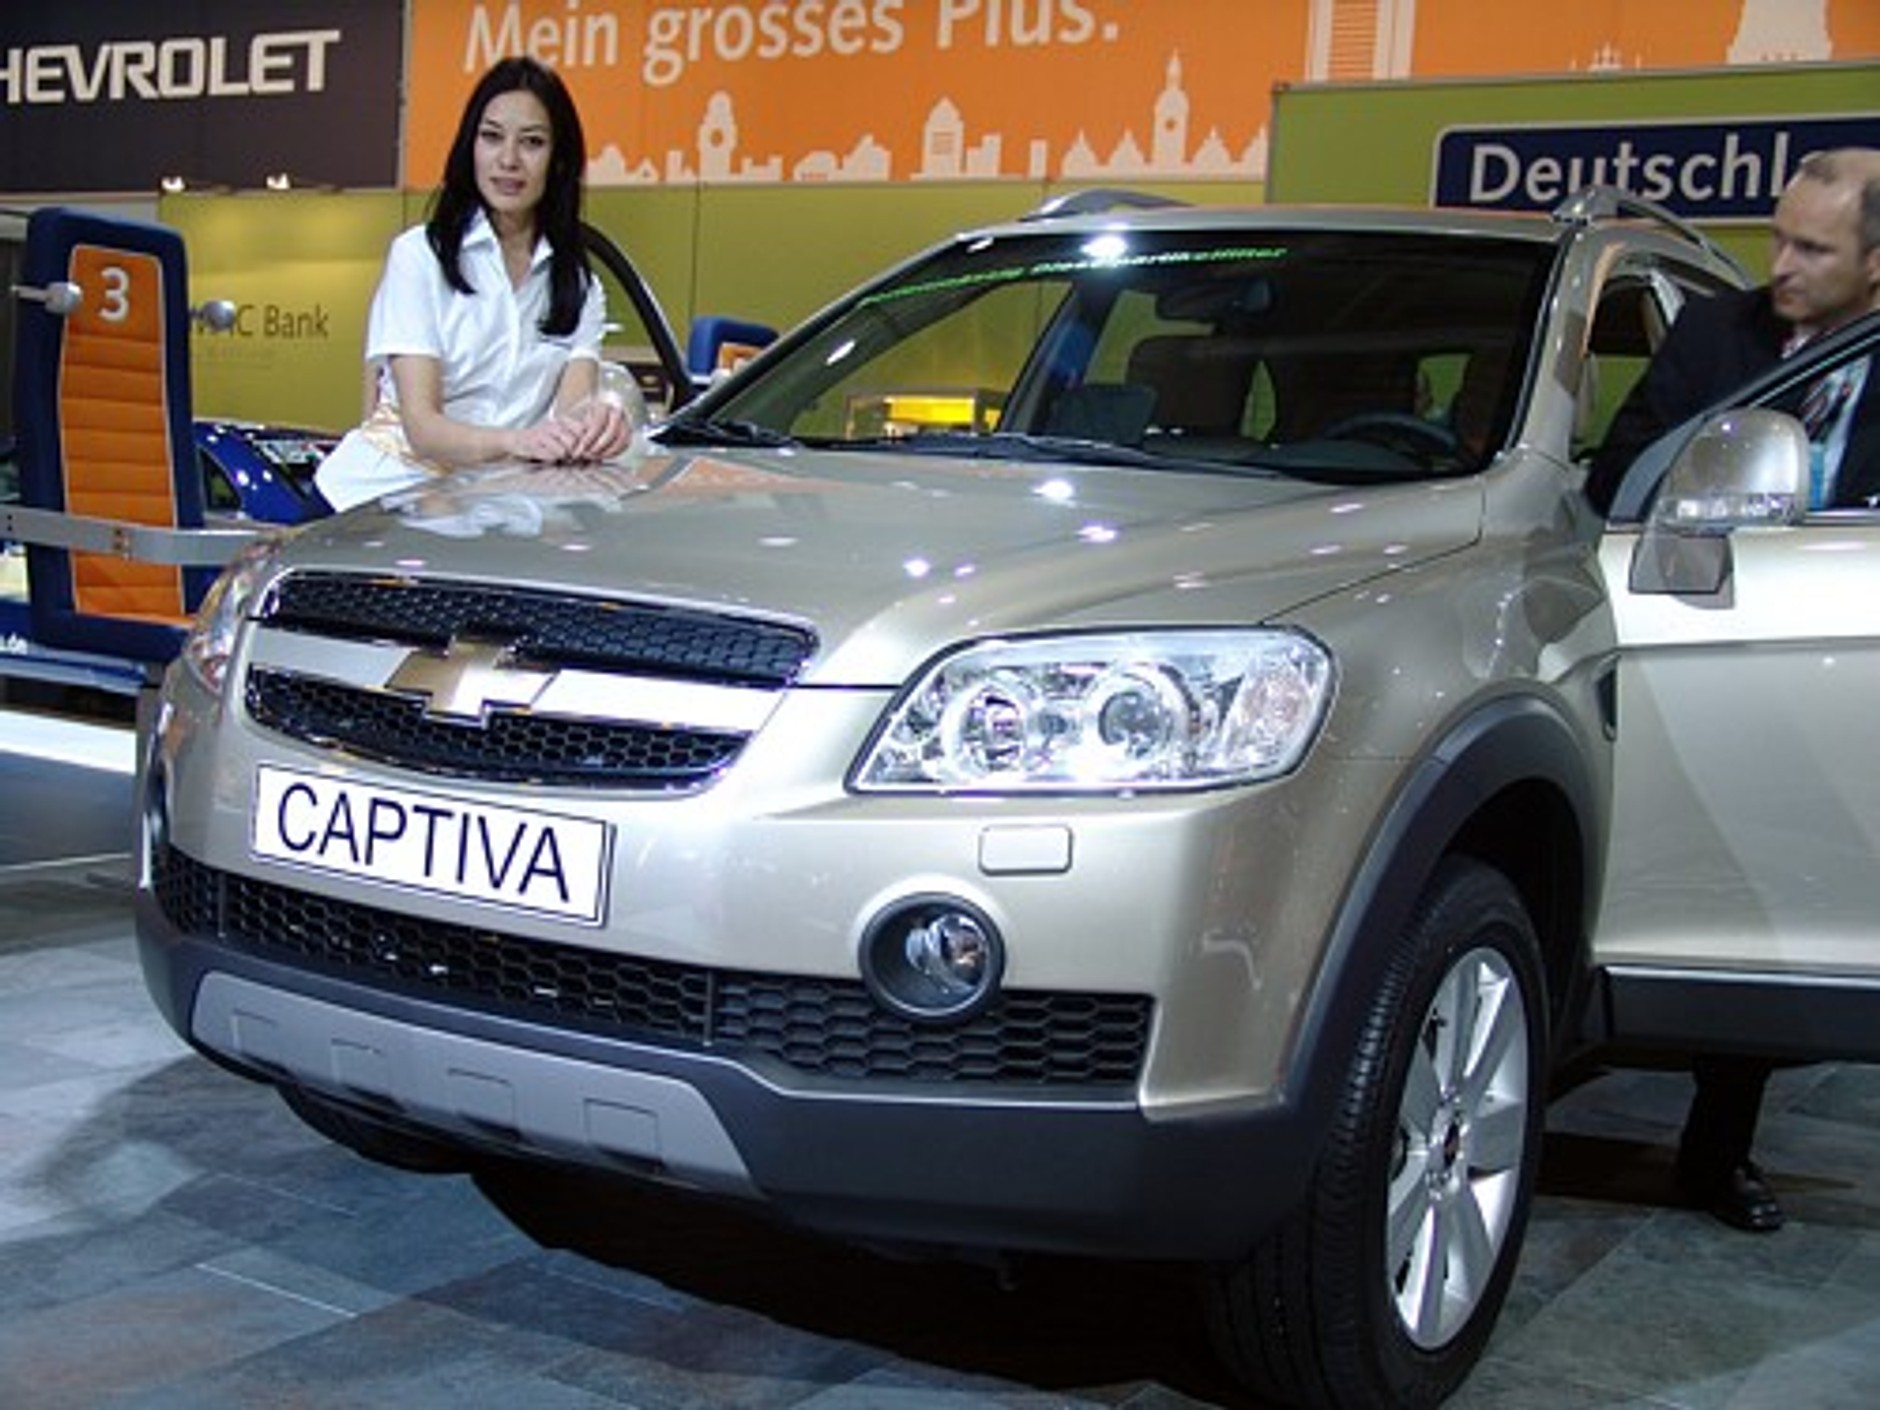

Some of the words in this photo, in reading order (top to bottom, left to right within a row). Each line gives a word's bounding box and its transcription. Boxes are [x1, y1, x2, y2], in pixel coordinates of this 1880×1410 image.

[464, 0, 618, 73] Mein
[643, 0, 904, 87] grosses
[937, 0, 1119, 50] Plus.
[100, 266, 129, 322] 3
[263, 303, 328, 338] Bank
[278, 783, 570, 903] CAPTIVA
